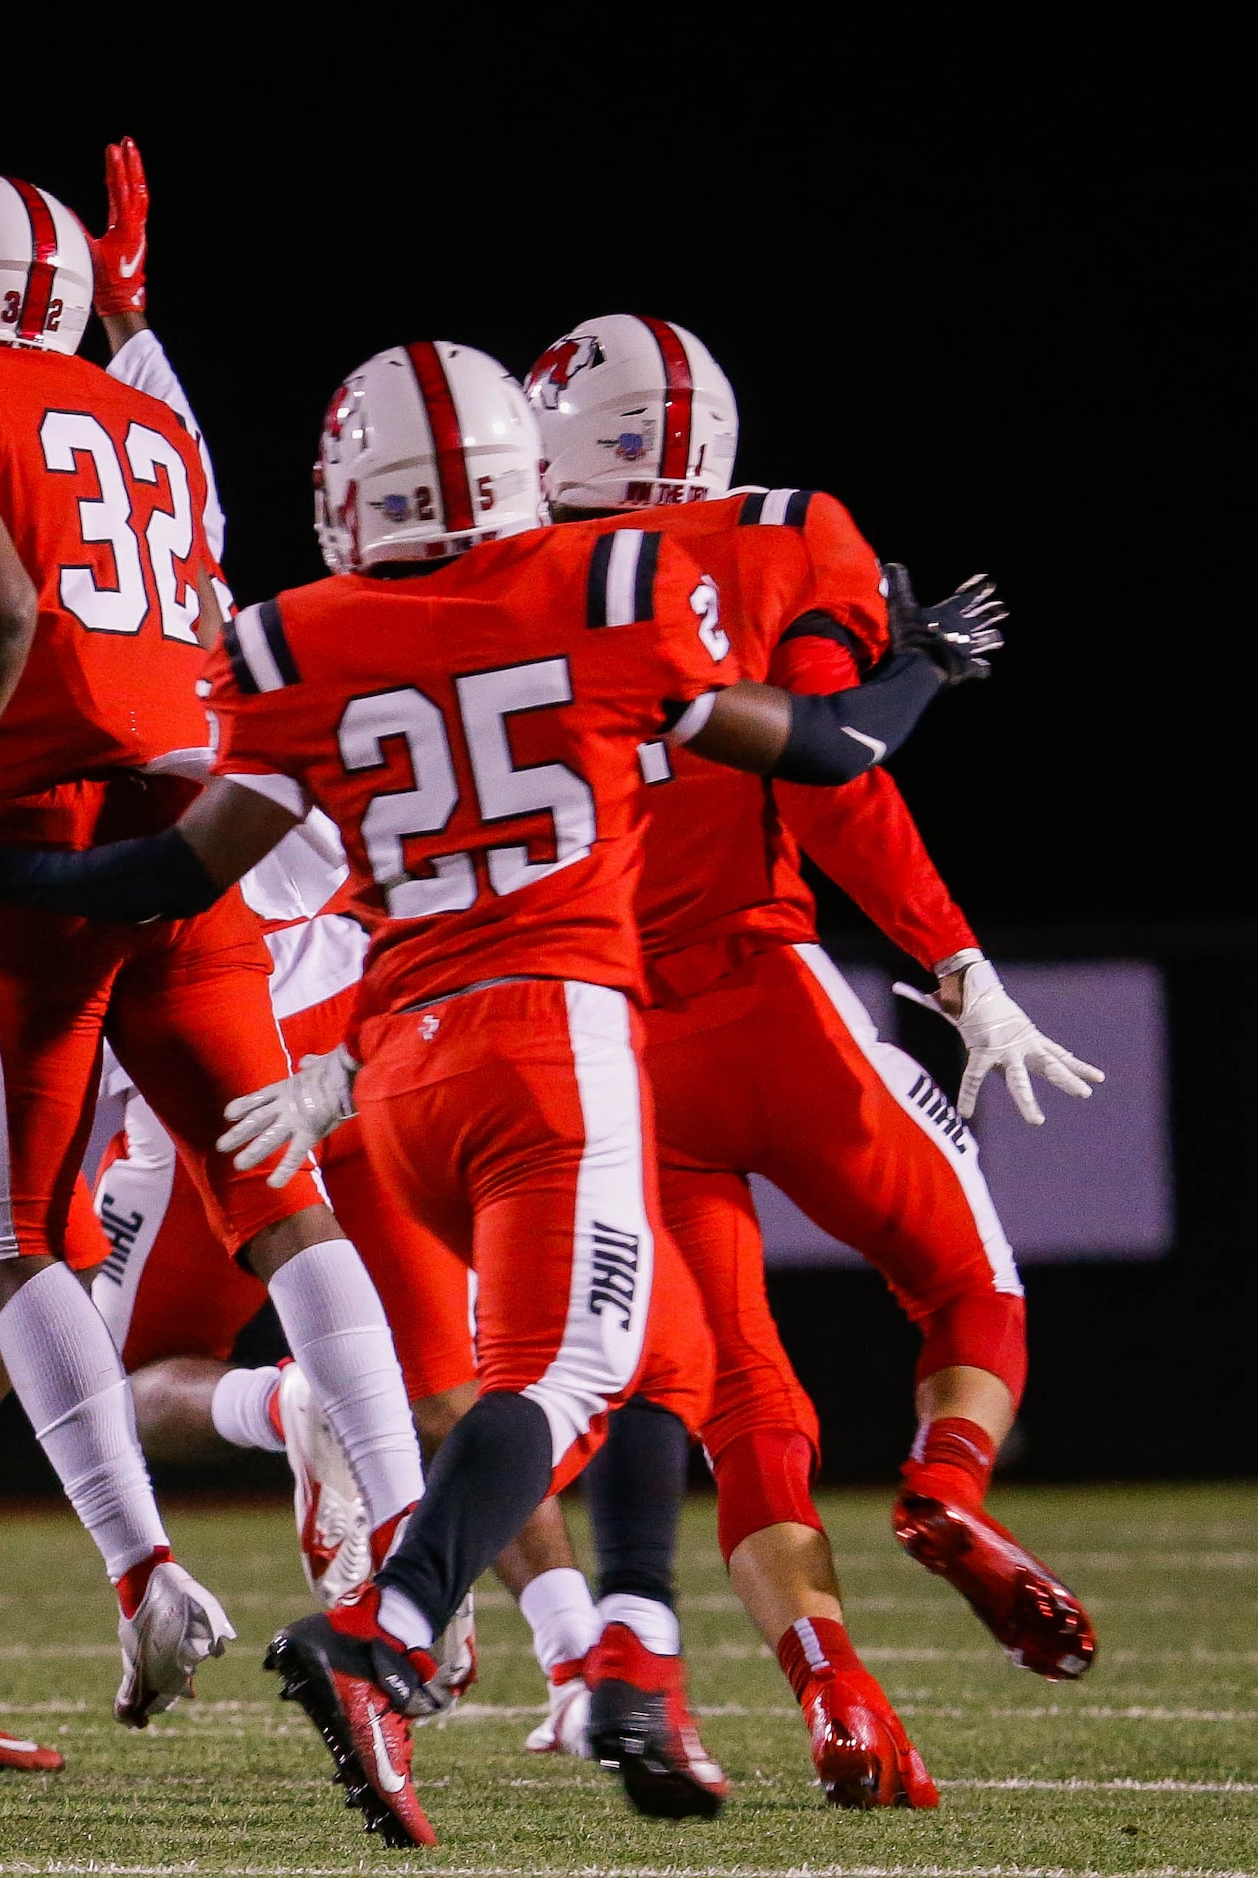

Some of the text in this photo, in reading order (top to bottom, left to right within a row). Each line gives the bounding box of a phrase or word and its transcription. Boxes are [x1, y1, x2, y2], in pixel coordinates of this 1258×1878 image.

[38, 408, 202, 648] 32
[688, 574, 731, 663] 2
[337, 654, 597, 920] 25
[591, 1221, 639, 1332] MAC
